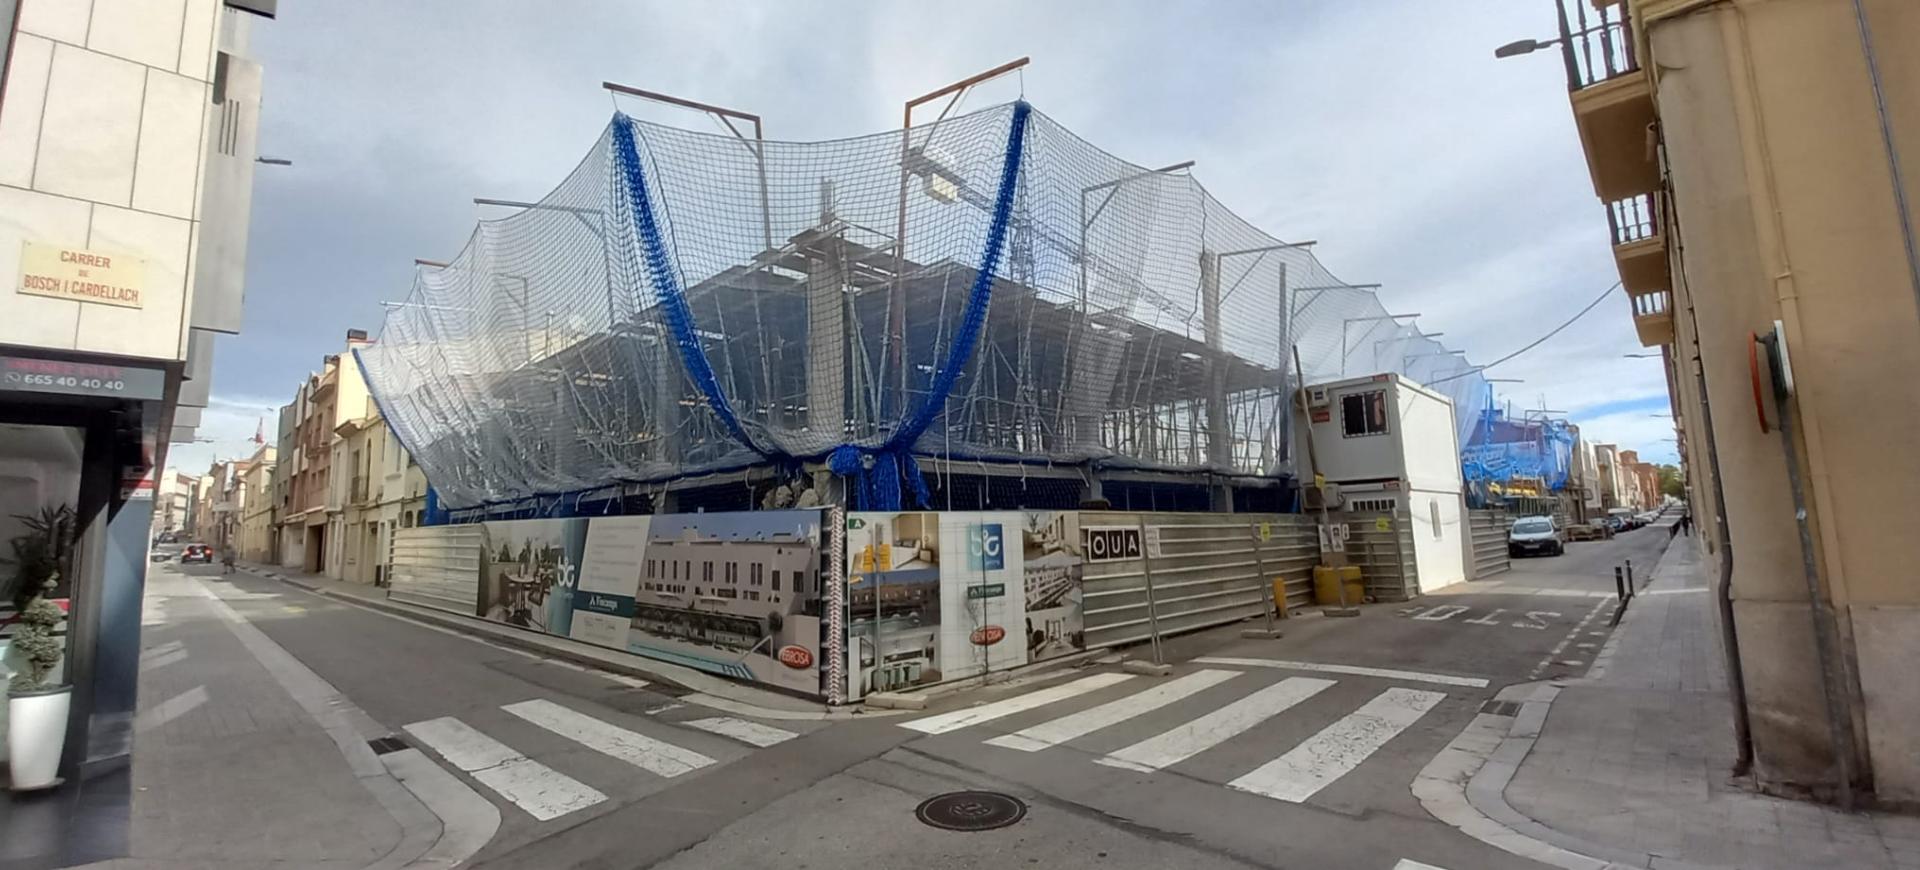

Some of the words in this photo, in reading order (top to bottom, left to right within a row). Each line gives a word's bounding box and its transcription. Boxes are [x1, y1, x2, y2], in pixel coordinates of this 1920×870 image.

[60, 250, 111, 269] CARRER
[24, 274, 60, 291] BOSCH
[64, 280, 68, 293] I
[71, 281, 139, 302] CARDELLACH
[24, 374, 53, 385] 665
[56, 377, 77, 387] 40
[81, 379, 101, 389] 40
[104, 380, 124, 390] 40
[1093, 534, 1138, 556] OUA
